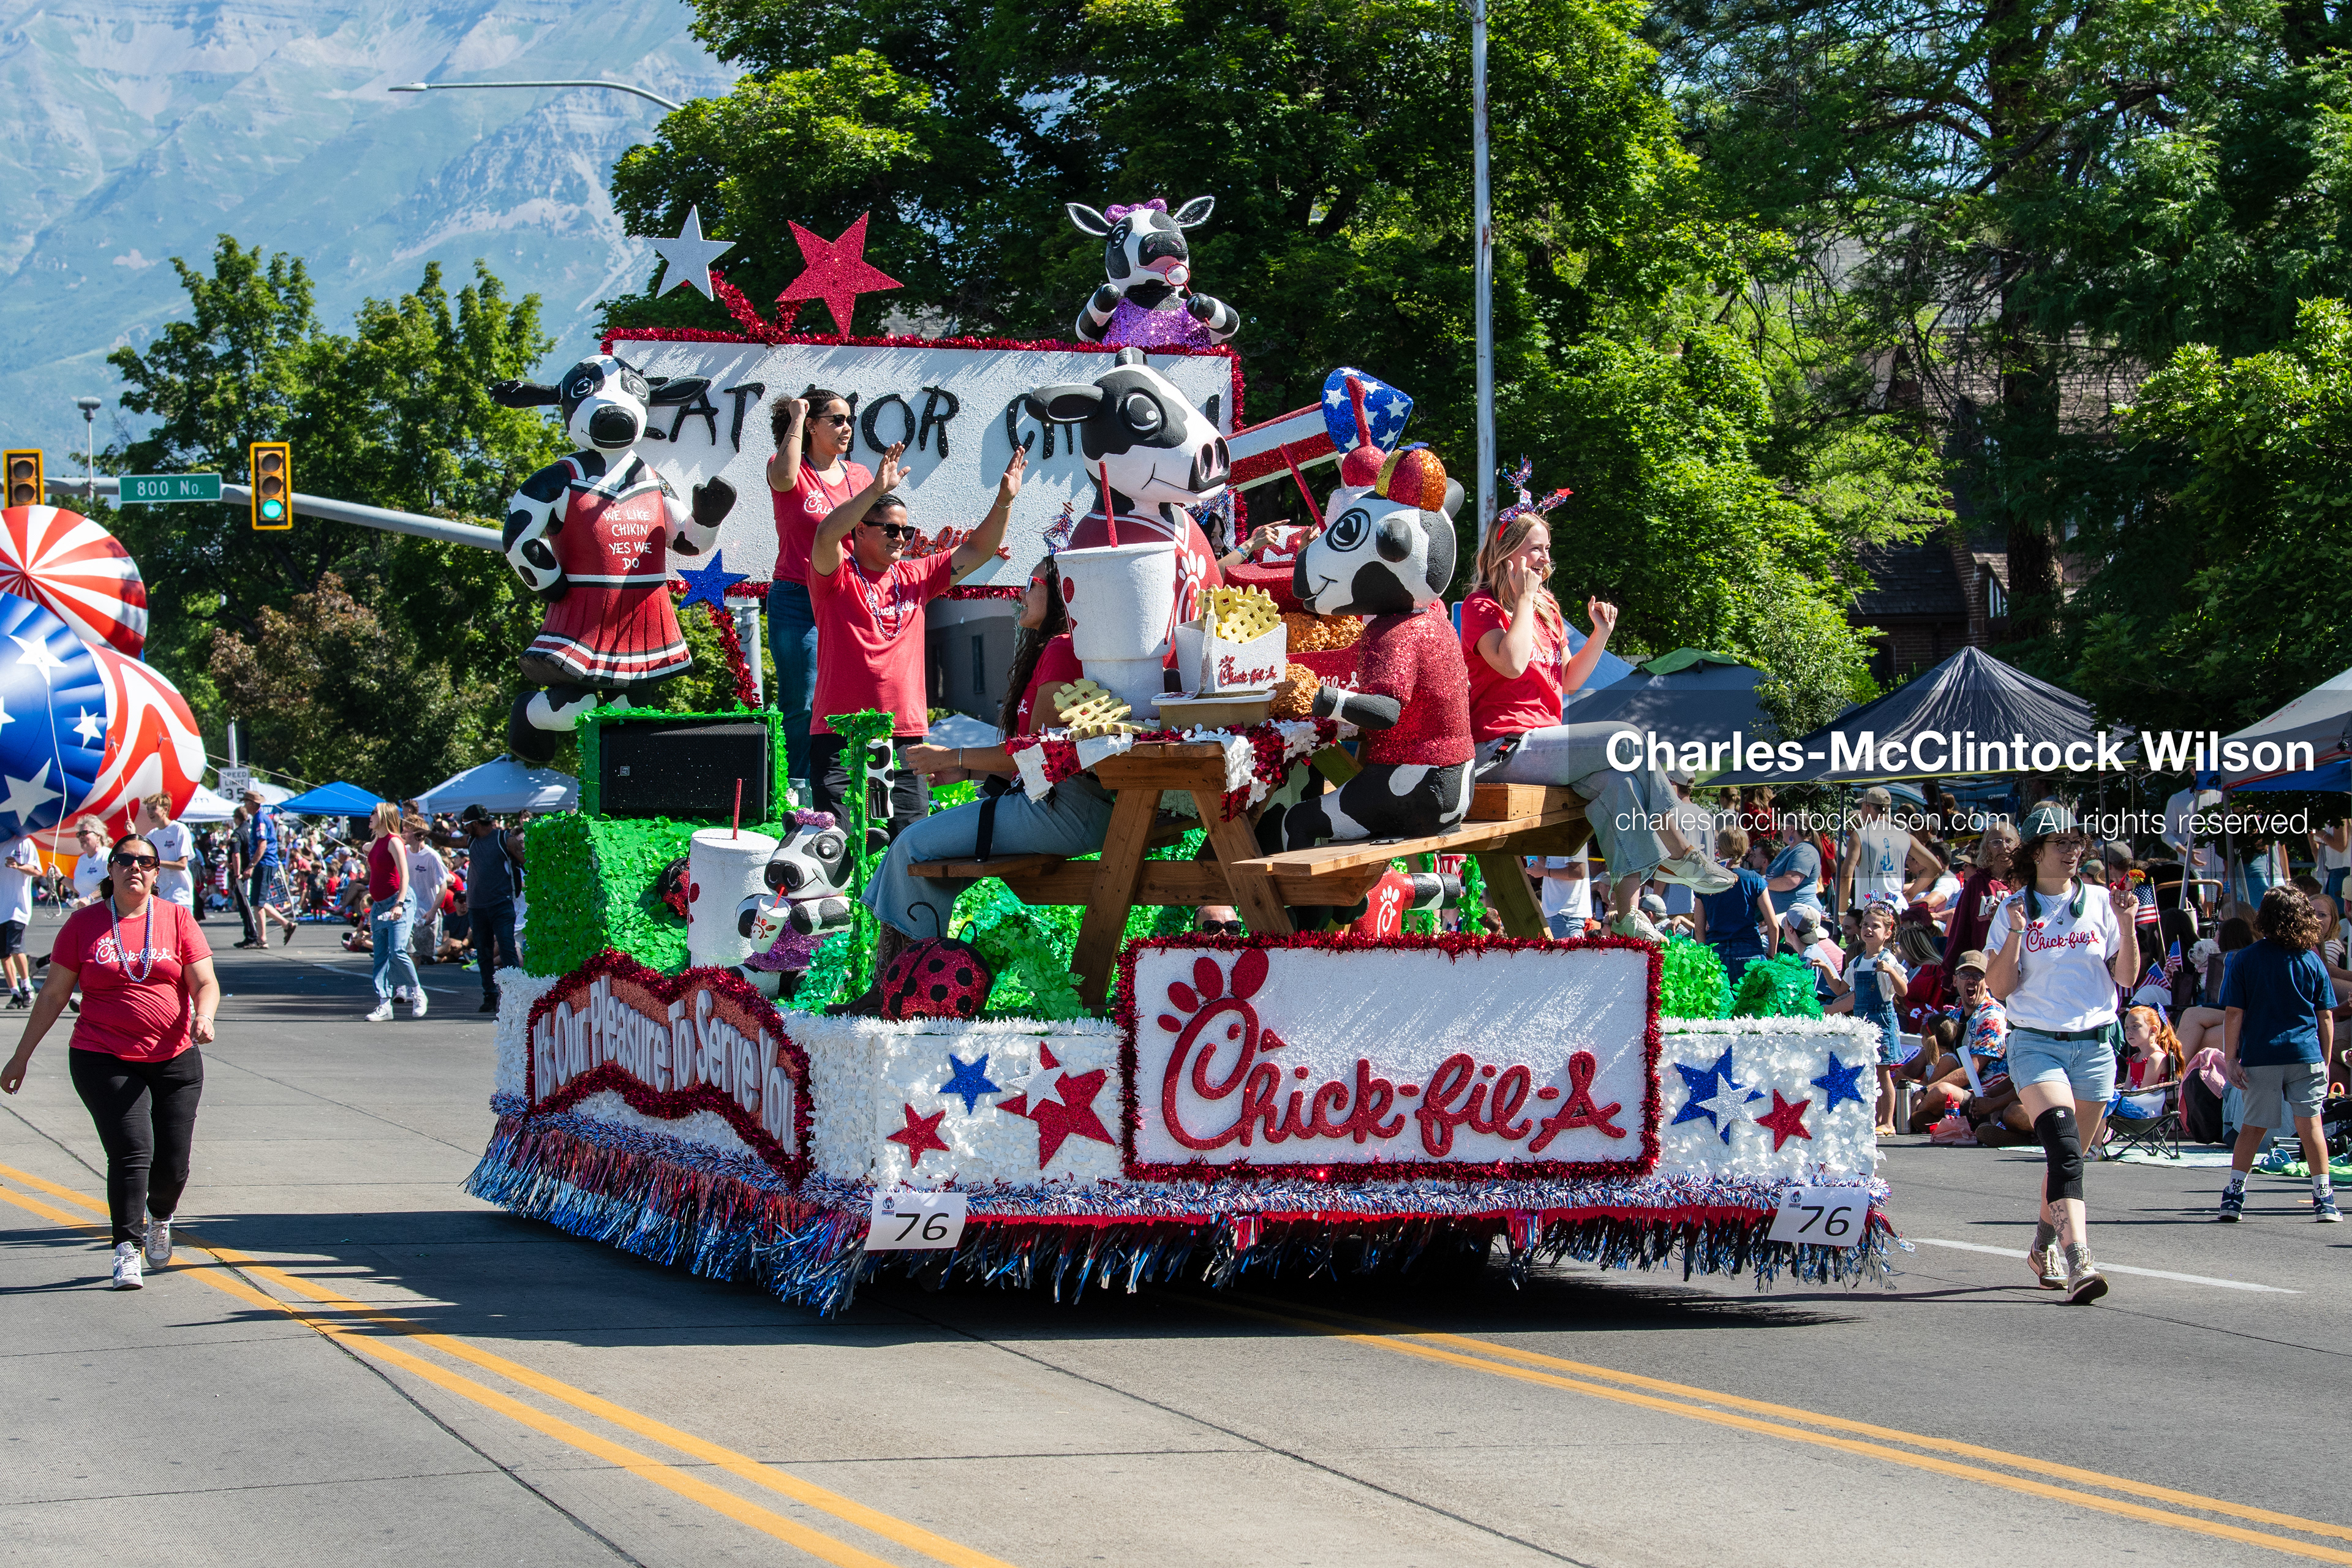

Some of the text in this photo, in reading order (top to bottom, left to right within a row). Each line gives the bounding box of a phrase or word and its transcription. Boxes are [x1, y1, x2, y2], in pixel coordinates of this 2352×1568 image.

[137, 480, 204, 496] 800 No.
[603, 510, 650, 521] WE LIKE
[611, 523, 648, 537] CHIKIN
[609, 541, 652, 555] YES WE
[622, 557, 639, 571] DO
[1219, 663, 1278, 685] Chick-fil-A
[225, 788, 246, 802] 35
[2026, 929, 2100, 952] Chick-fil-A
[533, 975, 795, 1156] It's Our Pleasure To Serve You
[1162, 997, 1627, 1156] Chick-fil-A
[894, 1213, 949, 1242] 76
[1797, 1206, 1852, 1237] 76
